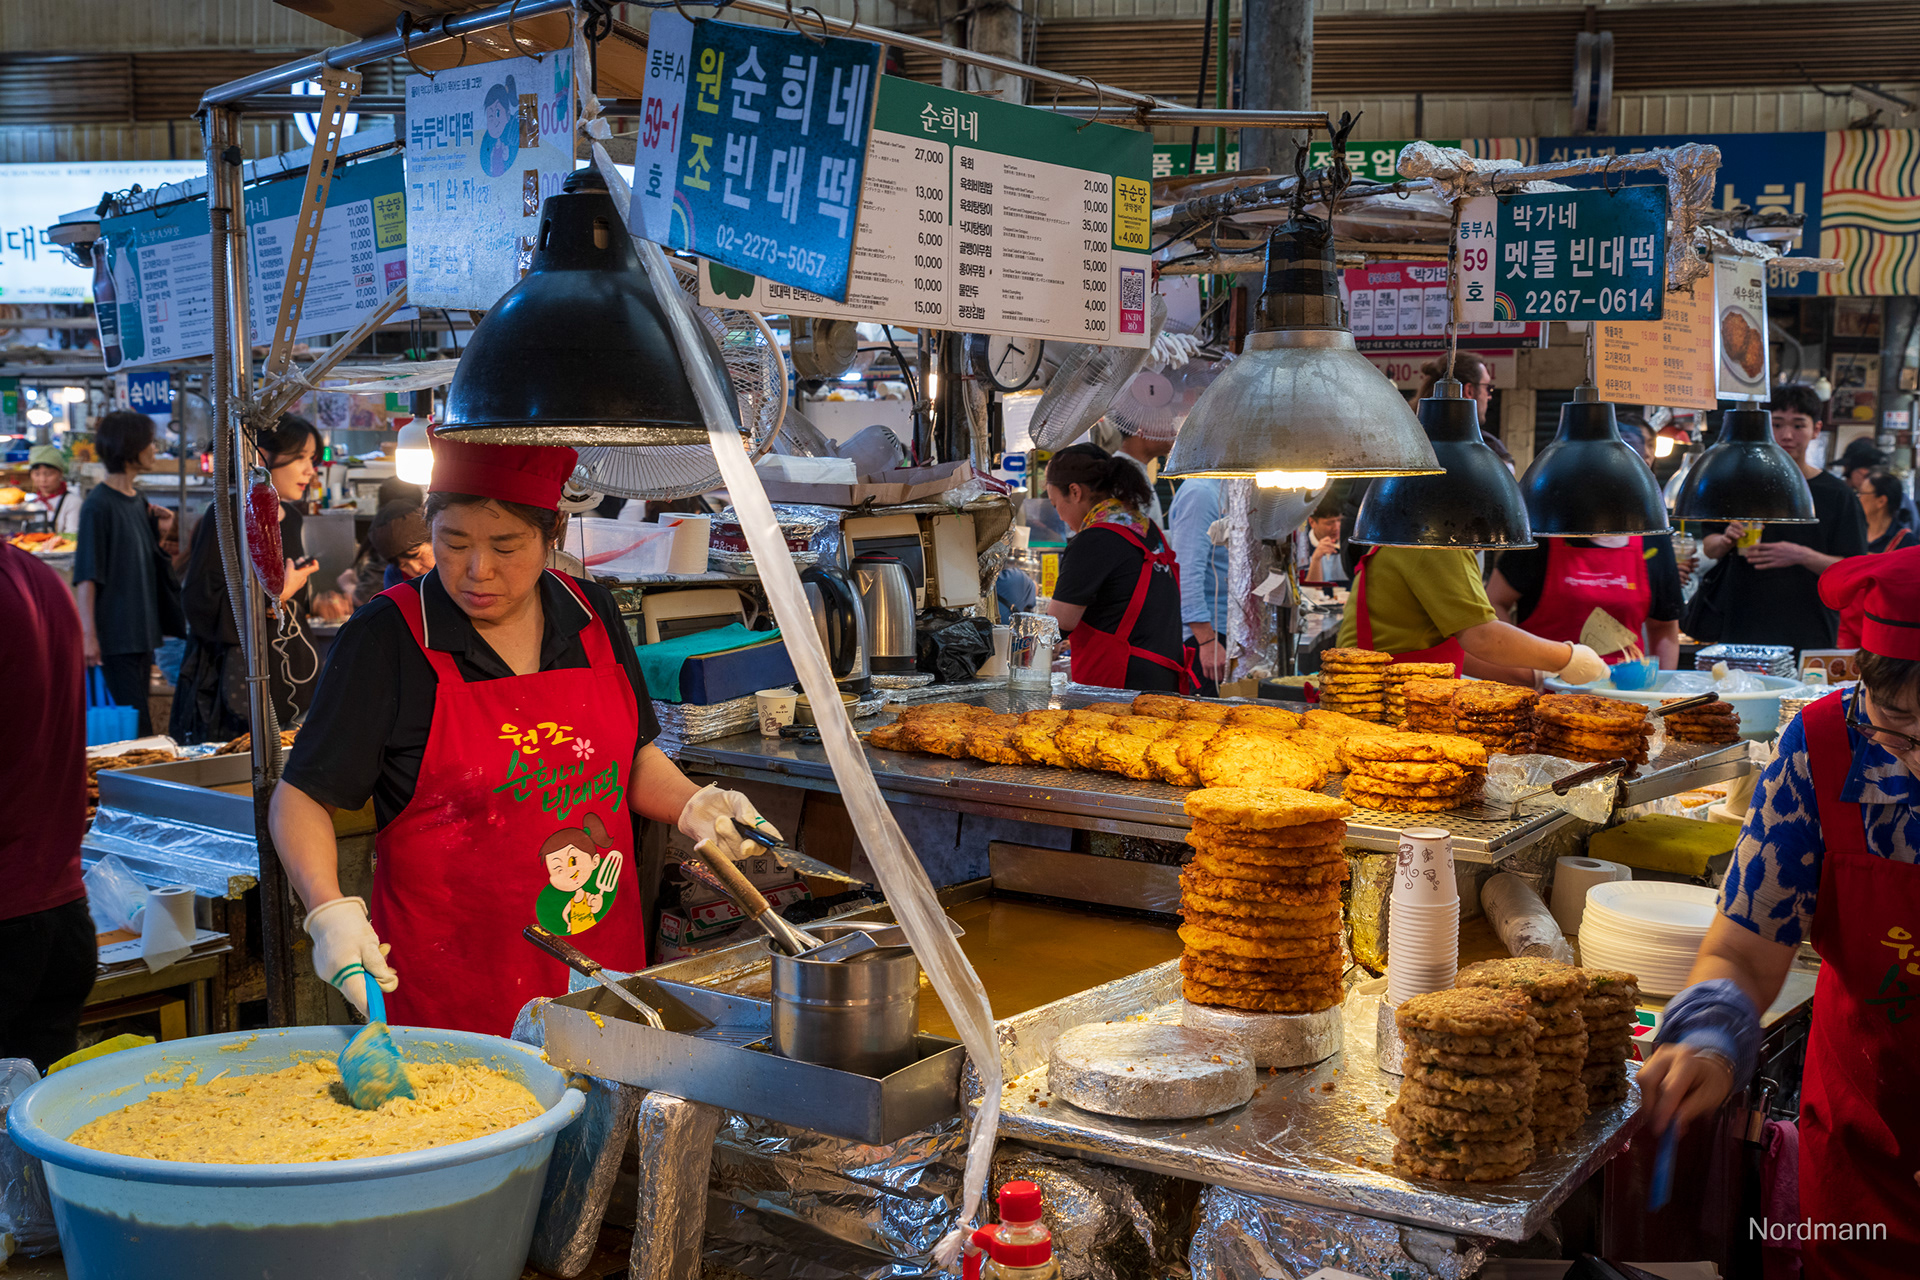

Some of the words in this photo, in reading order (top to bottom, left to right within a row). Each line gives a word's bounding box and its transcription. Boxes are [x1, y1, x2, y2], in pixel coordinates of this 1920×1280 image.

[651, 50, 684, 84] 동부A
[731, 46, 870, 146] 순희네
[643, 98, 679, 152] 59-1
[920, 102, 979, 142] 순희네
[412, 111, 474, 150] 녹두빈대떡
[915, 148, 944, 164] 27,000
[960, 156, 974, 170] 육회
[646, 163, 661, 199] 호
[723, 132, 856, 238] 빈대떡
[960, 178, 993, 195] 육회비빔밥
[1084, 180, 1108, 194] 21,000
[916, 186, 943, 201] 13,000
[1118, 184, 1146, 204] 국순당
[347, 204, 368, 216] 21,000
[377, 198, 401, 214] 국순당
[960, 199, 992, 216] 육회탕탕이
[1084, 200, 1108, 214] 10,000
[349, 216, 369, 228] 11,000
[918, 210, 942, 224] 5,000
[1513, 202, 1576, 232] 박가네
[350, 228, 370, 239] 11,000
[960, 220, 992, 236] 낙지탕탕이
[1082, 220, 1107, 233] 35,000
[1460, 221, 1494, 239] 동부A
[351, 240, 372, 252] 17,000
[918, 232, 942, 246] 6,000
[1084, 240, 1107, 252] 17,000
[716, 224, 826, 278] 02-2273-5057
[960, 242, 992, 258] 골뱅이무침
[1570, 235, 1654, 278] 빈대떡
[351, 252, 373, 264] 35,000
[914, 255, 942, 269] 10,000
[1463, 248, 1488, 272] 59
[352, 264, 374, 275] 35,000
[959, 263, 986, 278] 홍어무침
[1083, 260, 1106, 272] 15,000
[356, 286, 376, 298] 17,000
[914, 278, 942, 292] 10,000
[959, 284, 979, 298] 물만두
[1083, 280, 1106, 292] 15,000
[1466, 282, 1484, 302] 호
[355, 298, 378, 310] 40,000
[914, 301, 942, 314] 15,000
[1085, 300, 1106, 312] 4,000
[1525, 288, 1654, 314] 2267-0614
[958, 305, 985, 320] 광장김밥
[1085, 320, 1106, 332] 3,000
[130, 380, 168, 406] 숙이네
[498, 722, 574, 754] 원조
[542, 761, 624, 820] 빈대떡
